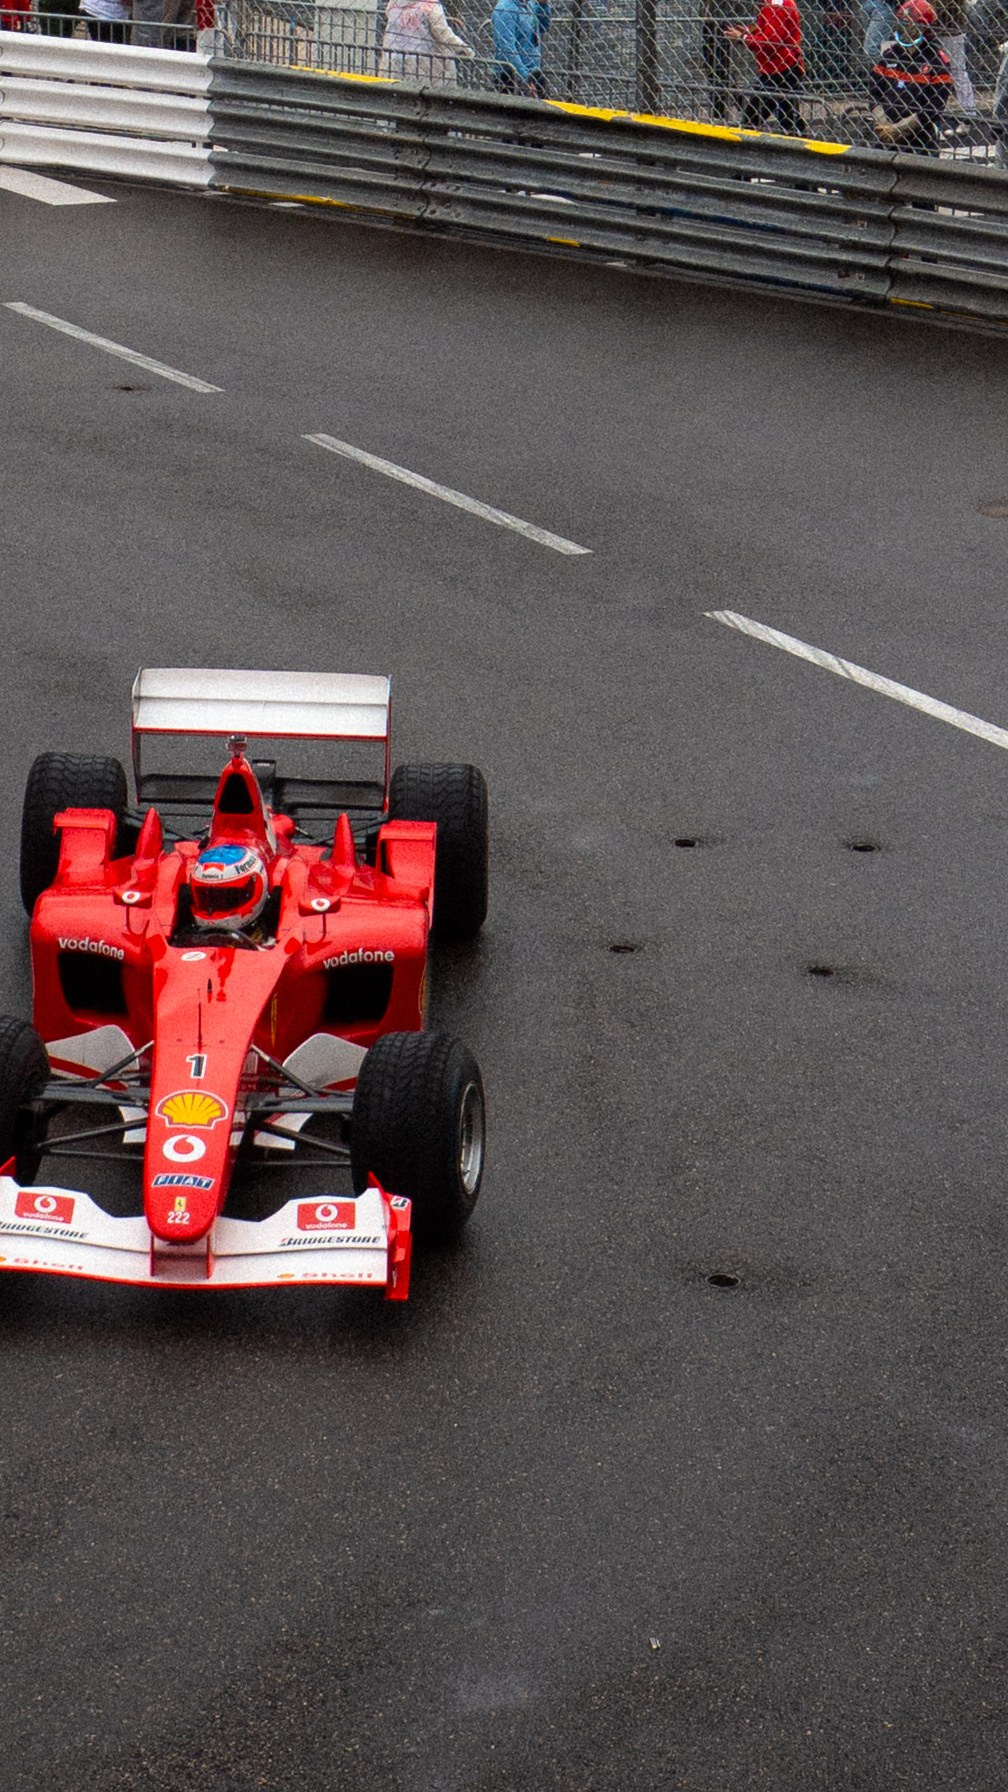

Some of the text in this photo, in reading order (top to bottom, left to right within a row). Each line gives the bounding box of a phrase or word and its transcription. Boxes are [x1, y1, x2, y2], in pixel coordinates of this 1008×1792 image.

[58, 937, 125, 960] vodafone
[323, 949, 395, 969] vodafone
[186, 1054, 208, 1079] 1
[154, 1175, 213, 1188] FIAT
[167, 1212, 190, 1225] 222
[278, 1235, 381, 1248] BRIDGESTONE
